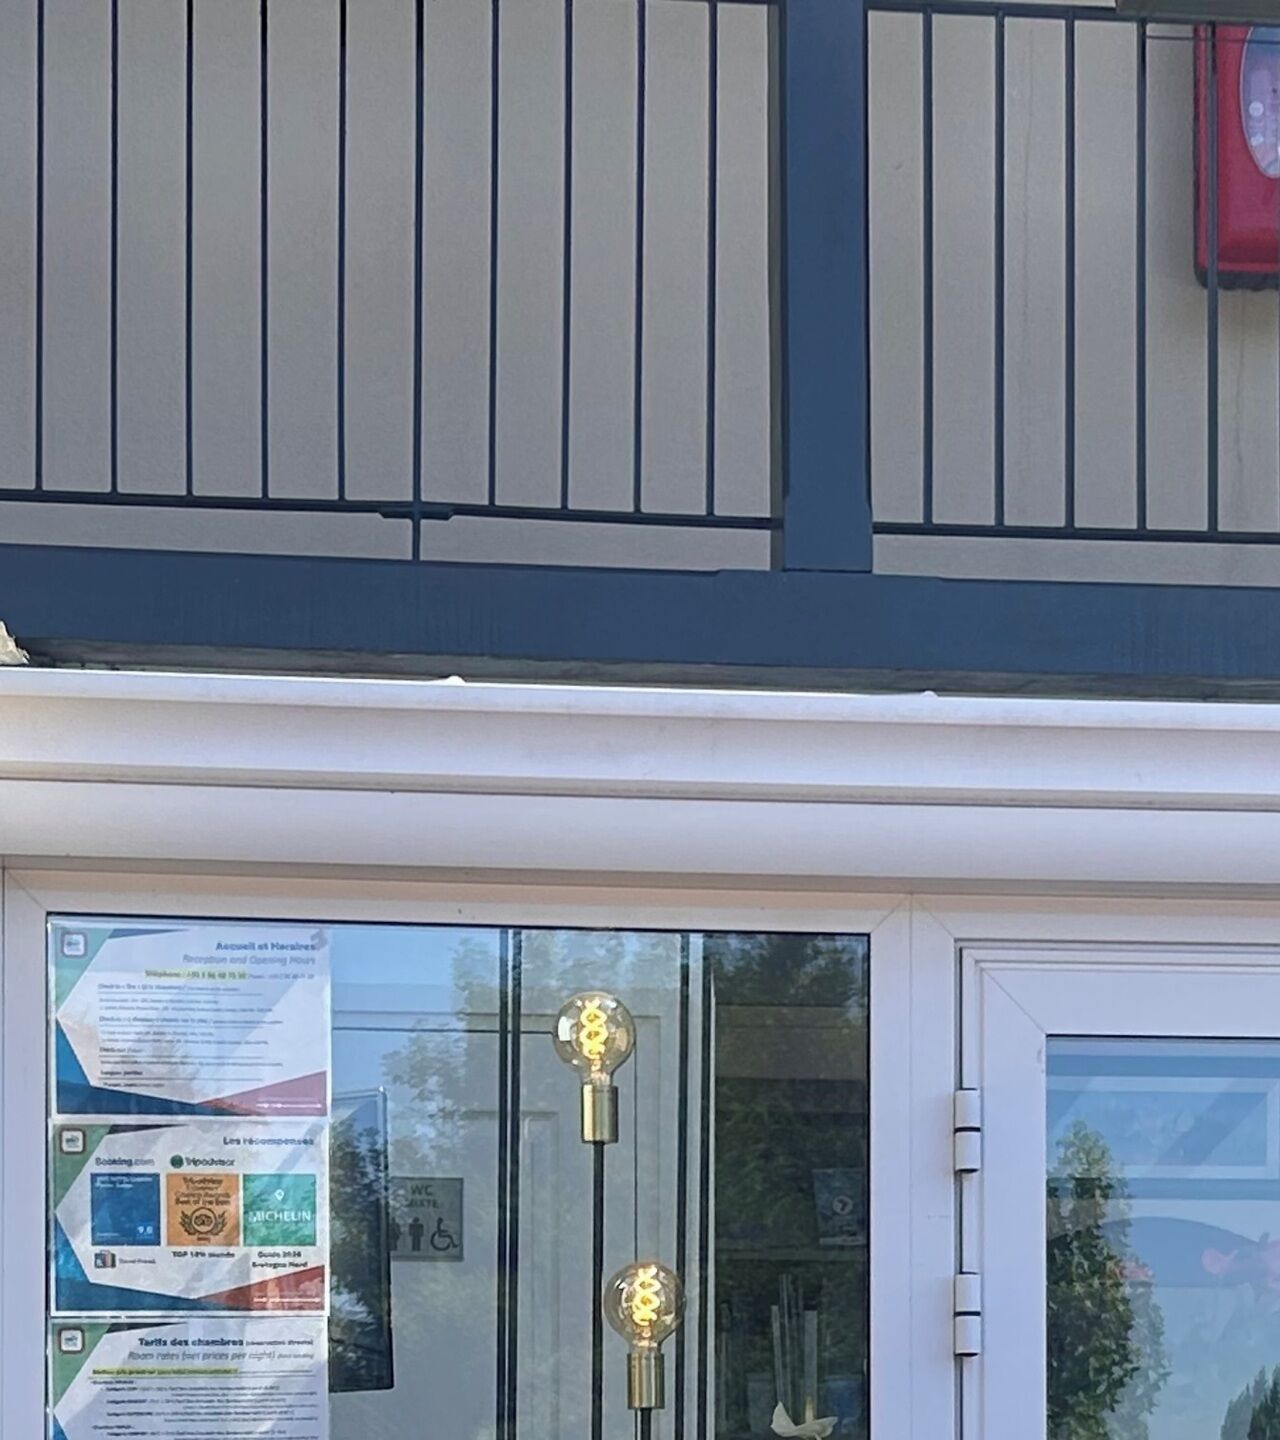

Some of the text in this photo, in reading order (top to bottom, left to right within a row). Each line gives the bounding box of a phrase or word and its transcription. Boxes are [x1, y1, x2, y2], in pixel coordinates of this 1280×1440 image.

[216, 942, 256, 951] Accueil
[257, 943, 269, 951] et
[223, 1136, 315, 1147] Les récompenses
[410, 1184, 433, 1196] WC
[249, 1210, 312, 1222] MICHELIN
[138, 1338, 168, 1347] Tarifs
[170, 1338, 190, 1347] des
[191, 1337, 244, 1347] chambres
